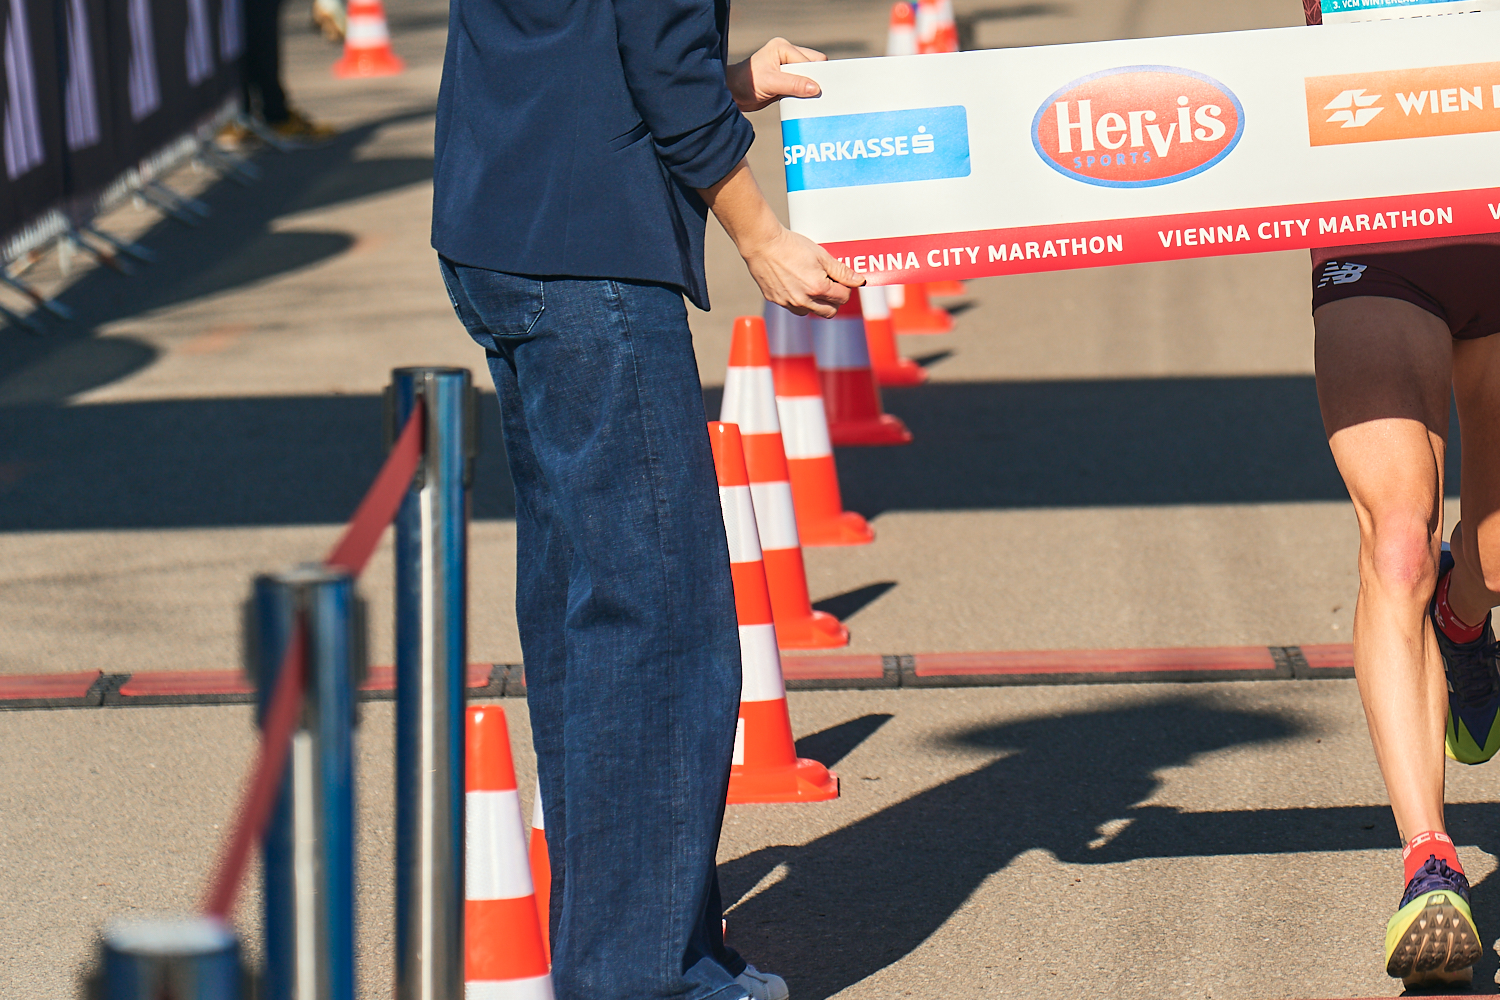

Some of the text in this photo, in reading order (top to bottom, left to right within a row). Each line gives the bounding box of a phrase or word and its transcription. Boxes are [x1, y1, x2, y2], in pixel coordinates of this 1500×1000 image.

[1332, 1, 1341, 10] 3.
[1395, 86, 1483, 118] WIEN
[1055, 96, 1226, 158] Hervis
[783, 136, 909, 166] SPARKASSE
[1073, 150, 1152, 169] SPORTS
[1157, 206, 1454, 248] VIENNA CITY MARATHON
[927, 245, 981, 269] CITY
[988, 234, 1124, 262] MARATHON
